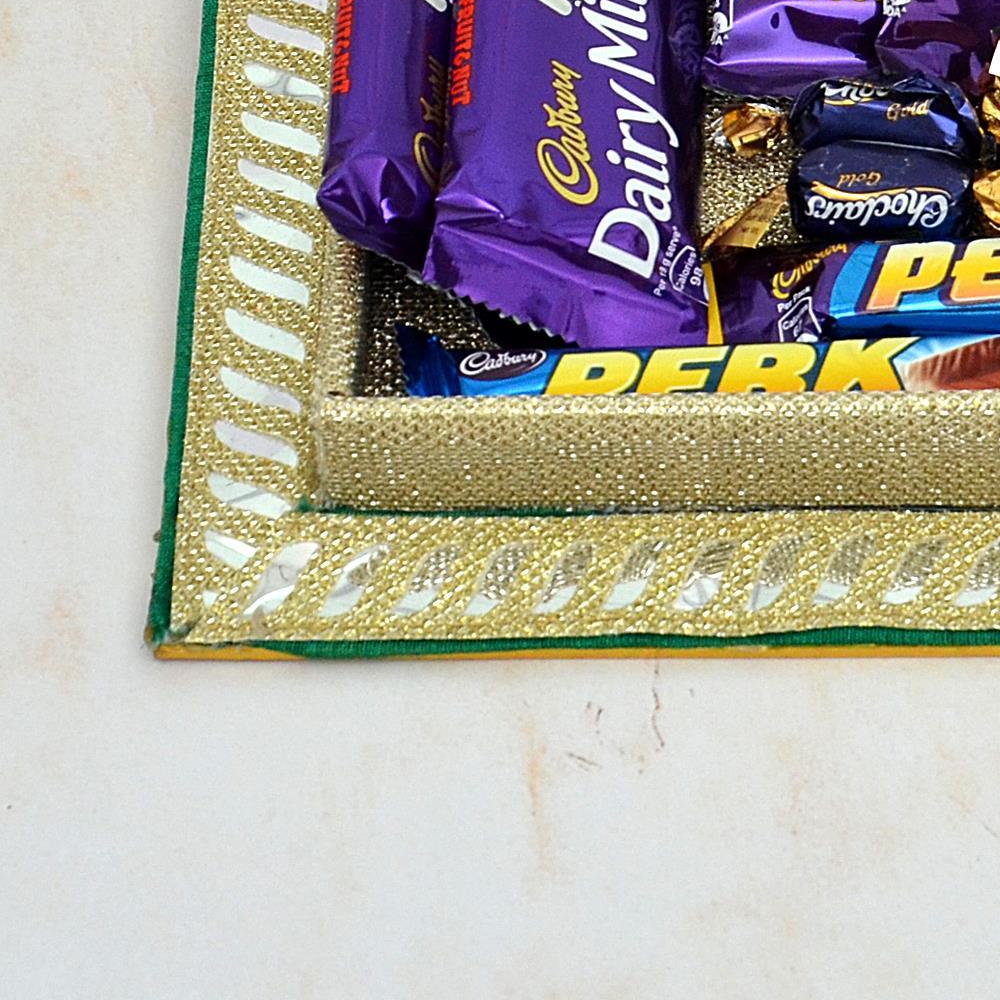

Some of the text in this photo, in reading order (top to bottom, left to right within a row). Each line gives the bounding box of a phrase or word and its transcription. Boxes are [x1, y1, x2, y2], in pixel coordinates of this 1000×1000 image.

[536, 60, 599, 206] Cadbury
[588, 78, 680, 279] Dairy
[837, 171, 882, 188] Gold
[805, 188, 950, 229] Choclairs
[653, 279, 668, 297] Per
[675, 251, 697, 291] Calories
[460, 350, 537, 376] Cadbury
